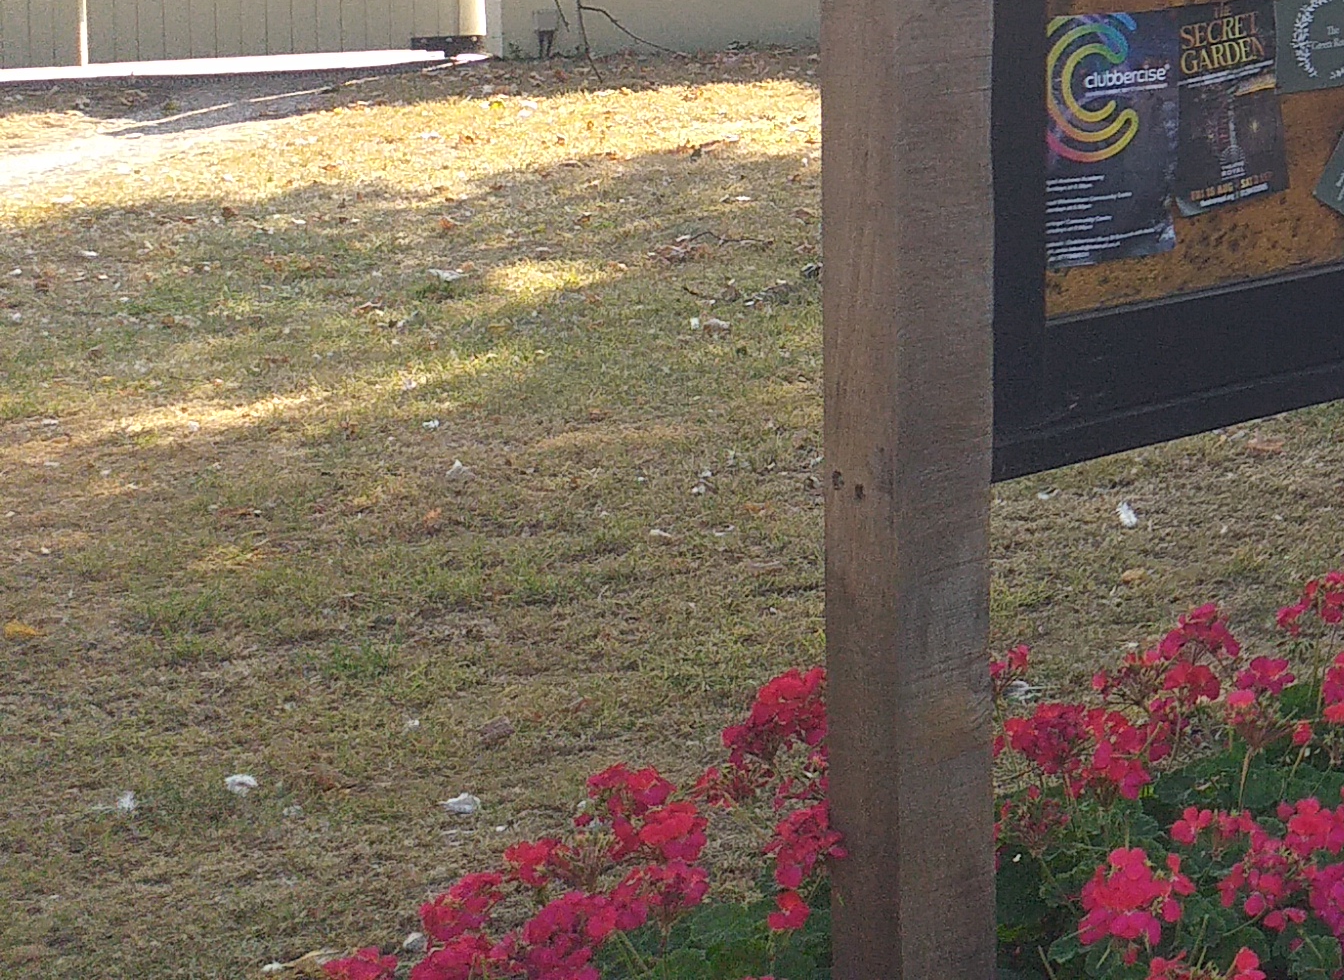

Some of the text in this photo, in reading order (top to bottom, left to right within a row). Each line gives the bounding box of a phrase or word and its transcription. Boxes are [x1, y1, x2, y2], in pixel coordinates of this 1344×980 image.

[1180, 11, 1259, 50] SECRET
[1326, 24, 1340, 36] The
[1180, 36, 1265, 76] GARDEN
[1085, 65, 1167, 89] clubbercise
